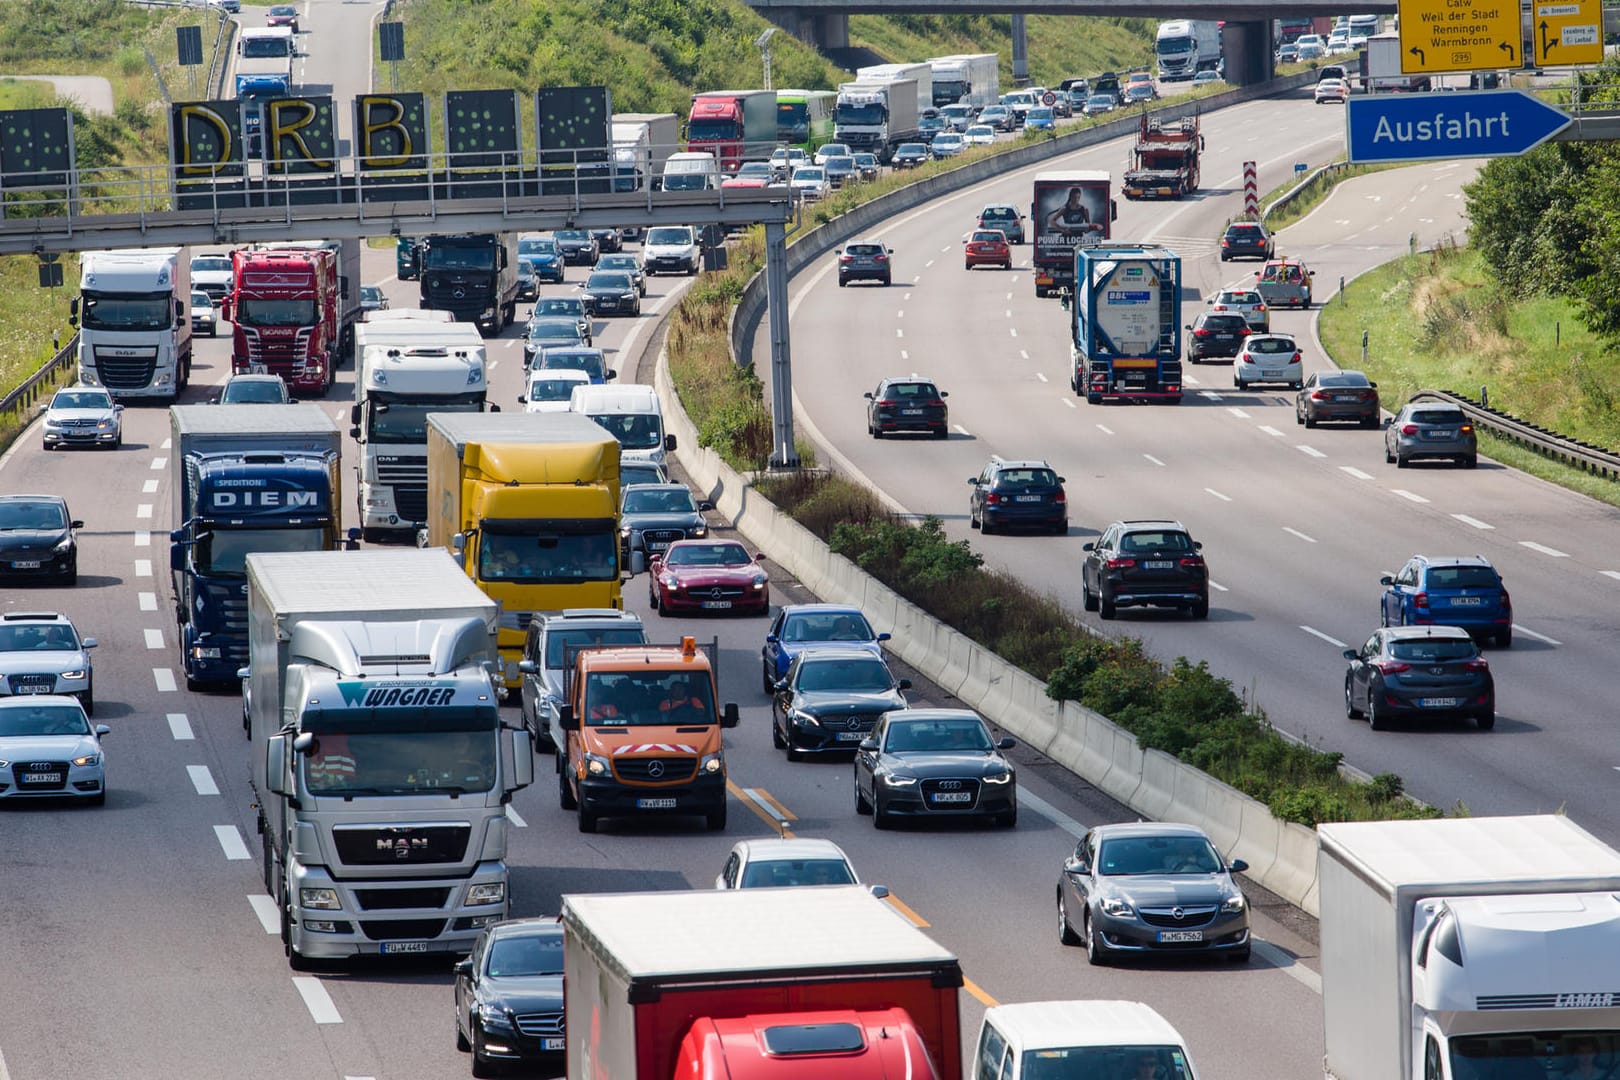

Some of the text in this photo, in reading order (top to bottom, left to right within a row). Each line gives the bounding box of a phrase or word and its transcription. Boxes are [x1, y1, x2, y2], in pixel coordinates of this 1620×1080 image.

[1421, 9, 1499, 21] Weil der Stadt
[1433, 24, 1488, 35] Renningen
[1431, 37, 1492, 47] Warmbronn
[1373, 111, 1510, 143] Ausfahrt
[1038, 236, 1065, 245] POWER
[218, 479, 262, 487] SPEDITION
[213, 491, 318, 506] DIEM
[364, 688, 456, 706] WAGNER
[377, 838, 428, 849] MAN
[1555, 993, 1614, 1007] LAMAR
